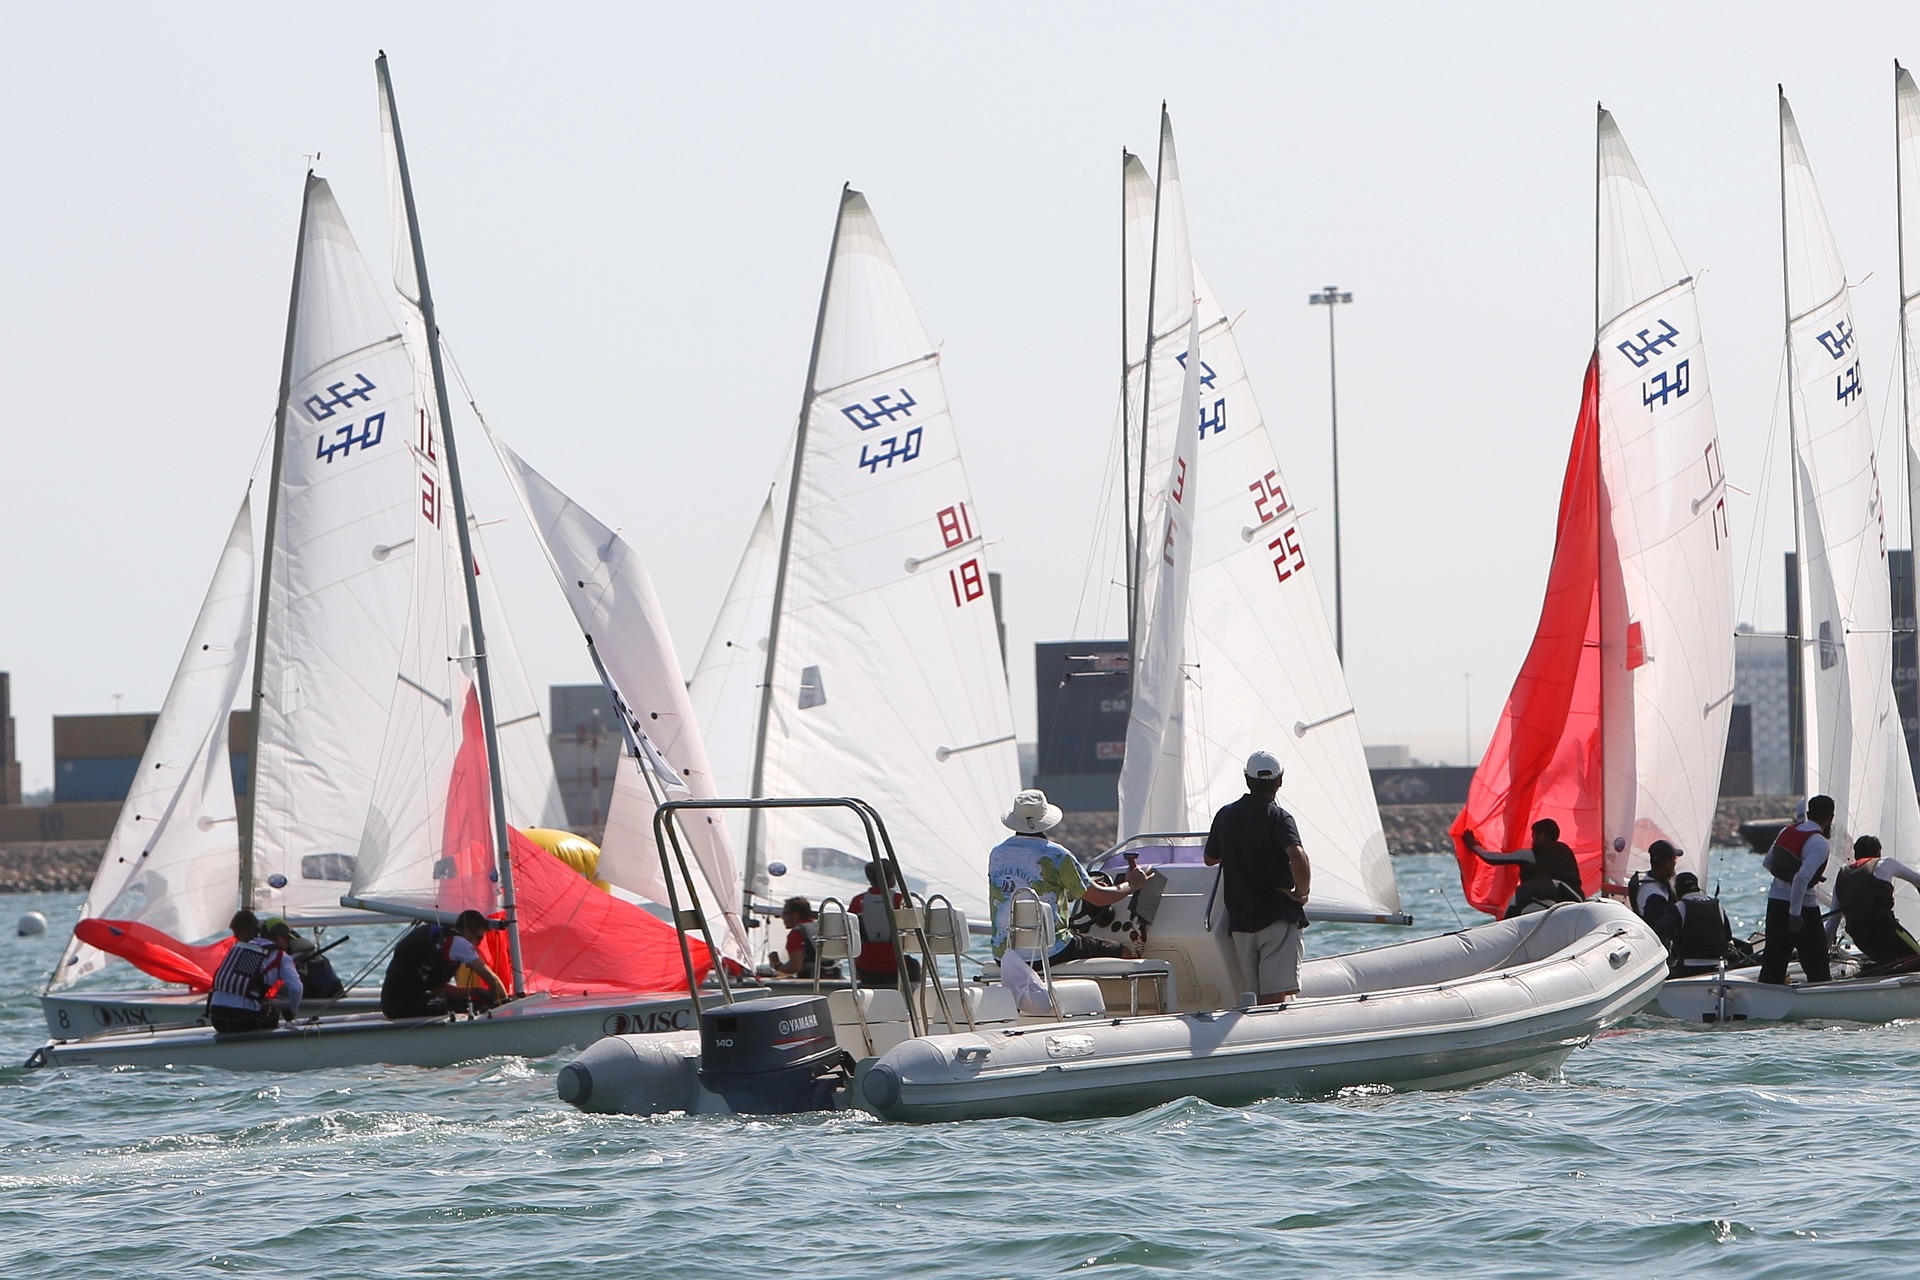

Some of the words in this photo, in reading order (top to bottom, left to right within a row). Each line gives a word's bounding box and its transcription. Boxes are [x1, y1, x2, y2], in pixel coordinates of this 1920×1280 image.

[1642, 357, 1690, 413] 470
[315, 410, 387, 465] 470
[858, 425, 924, 475] 470
[1248, 468, 1288, 524] 25
[1268, 526, 1306, 584] 25
[949, 557, 985, 609] 18
[58, 1009, 71, 1029] 8
[112, 1007, 157, 1026] MSC
[632, 1008, 690, 1033] MSC
[788, 1014, 819, 1032] YAMAHA
[715, 1039, 734, 1048] 140
